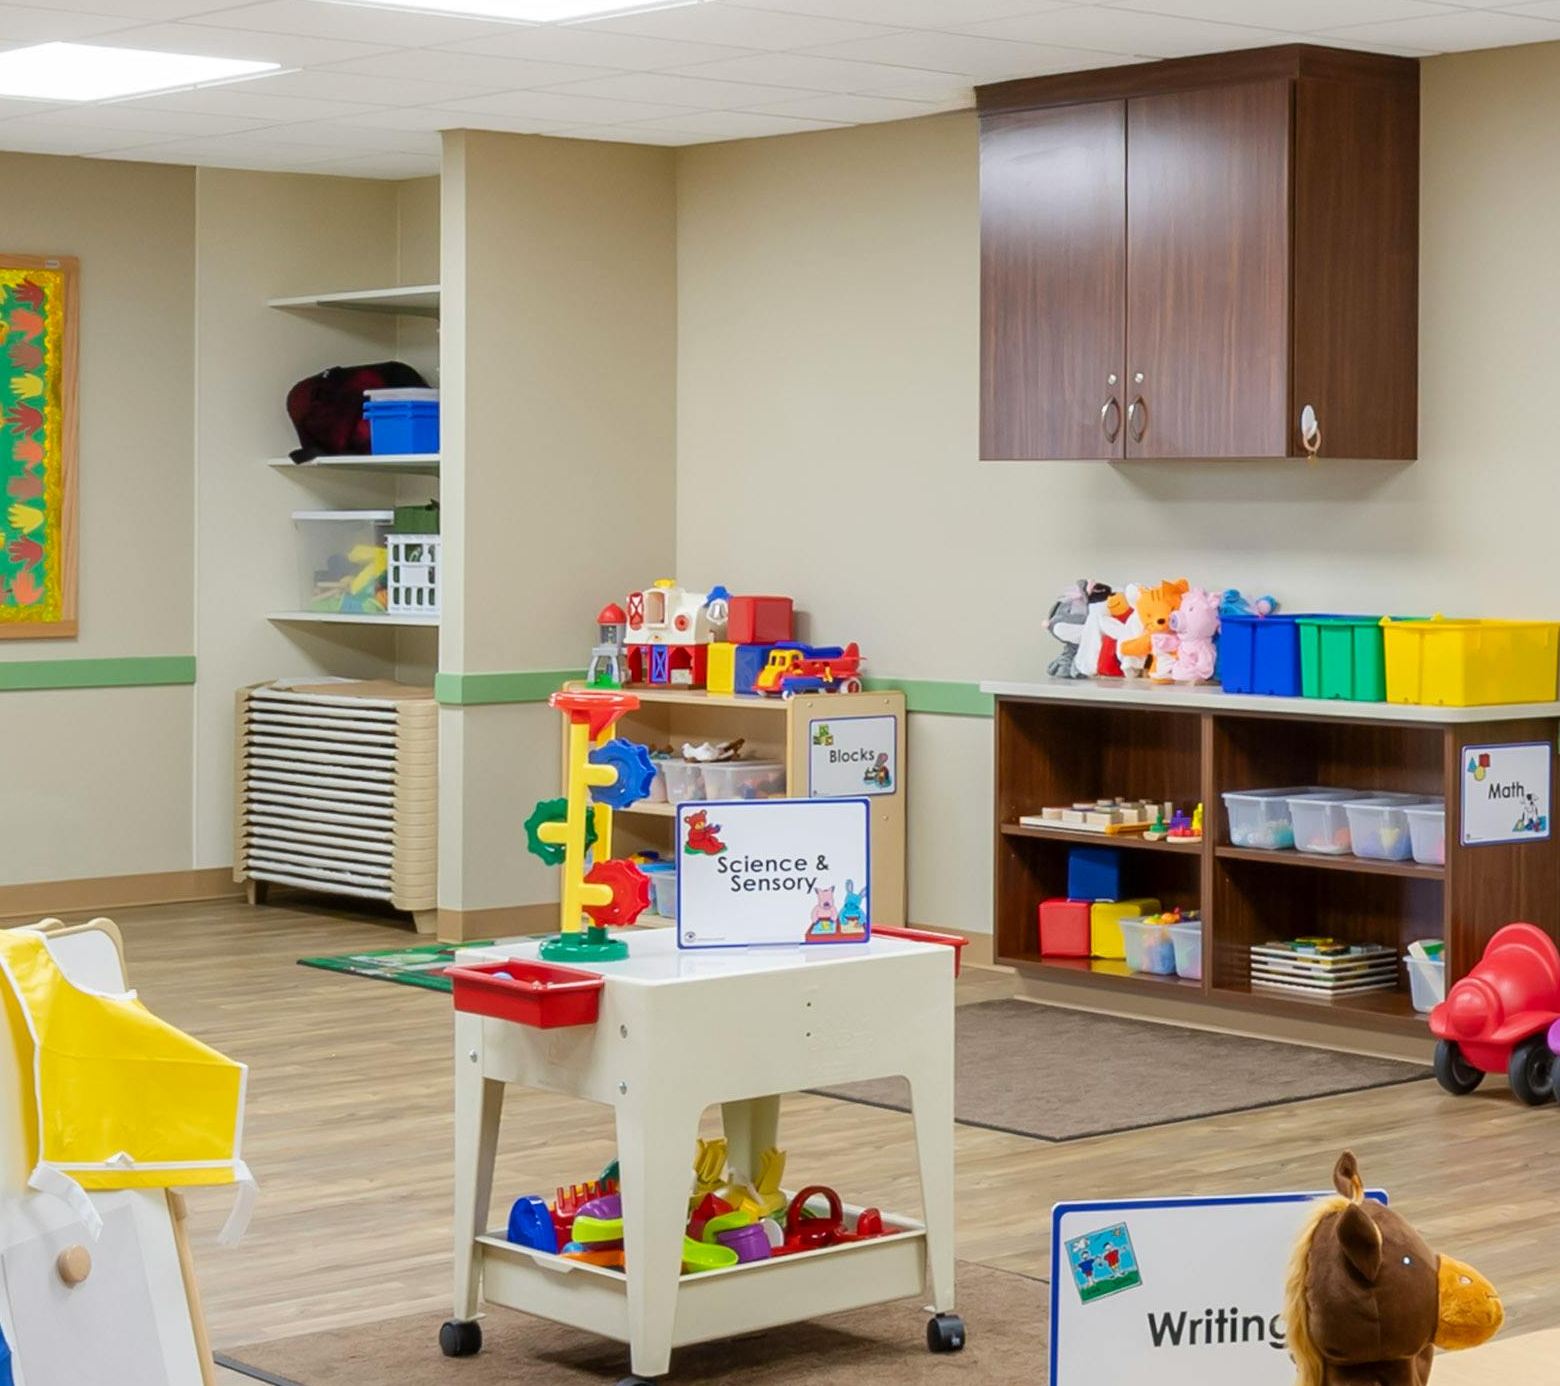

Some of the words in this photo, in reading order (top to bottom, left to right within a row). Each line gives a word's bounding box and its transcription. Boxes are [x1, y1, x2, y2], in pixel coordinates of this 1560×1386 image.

[829, 747, 875, 763] Blocks
[1488, 781, 1525, 800] Math
[717, 855, 808, 874] Science
[816, 854, 829, 871] &
[730, 874, 817, 894] Sensory
[1147, 1307, 1287, 1349] Writing
